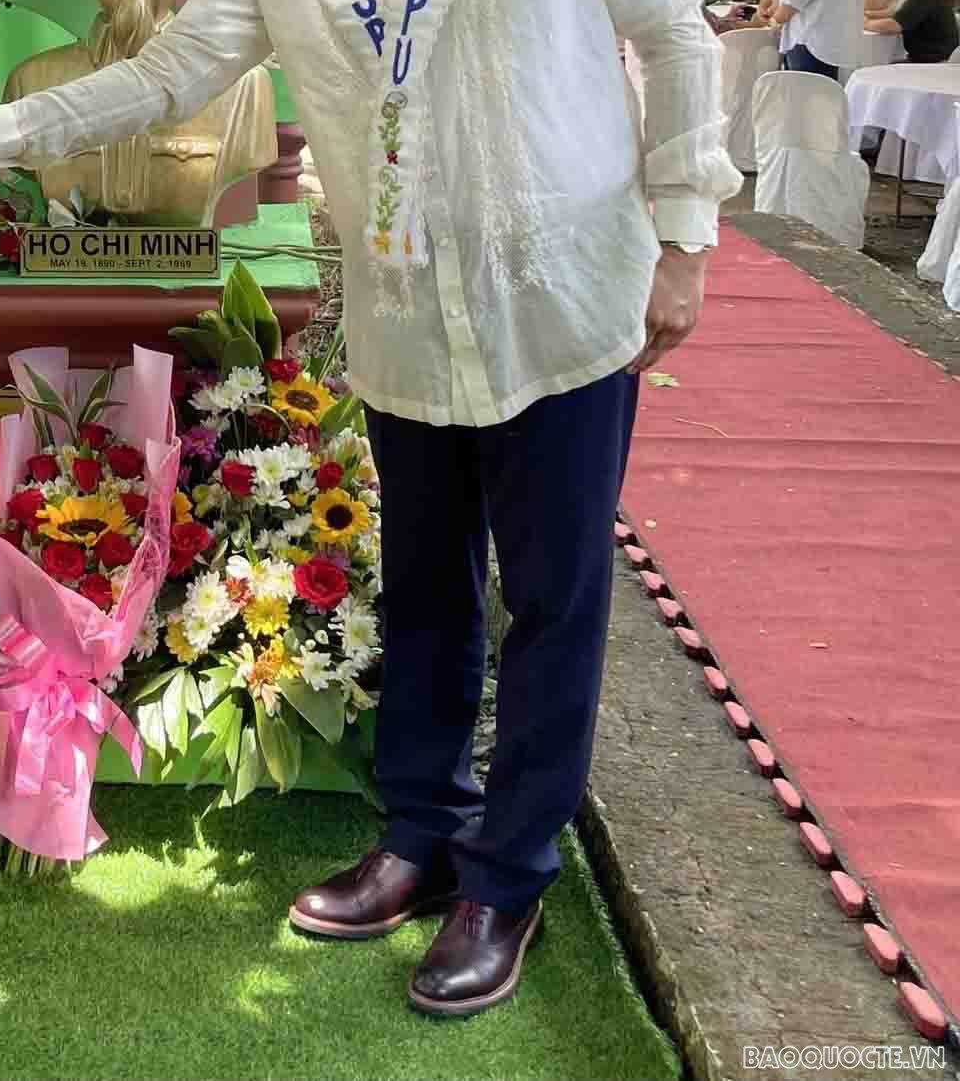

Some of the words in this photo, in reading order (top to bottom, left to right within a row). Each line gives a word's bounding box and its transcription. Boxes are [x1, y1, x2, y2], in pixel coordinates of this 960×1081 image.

[29, 234, 70, 255] HO
[81, 234, 129, 255] CHI
[141, 234, 214, 256] MINH
[50, 258, 71, 269] MAY
